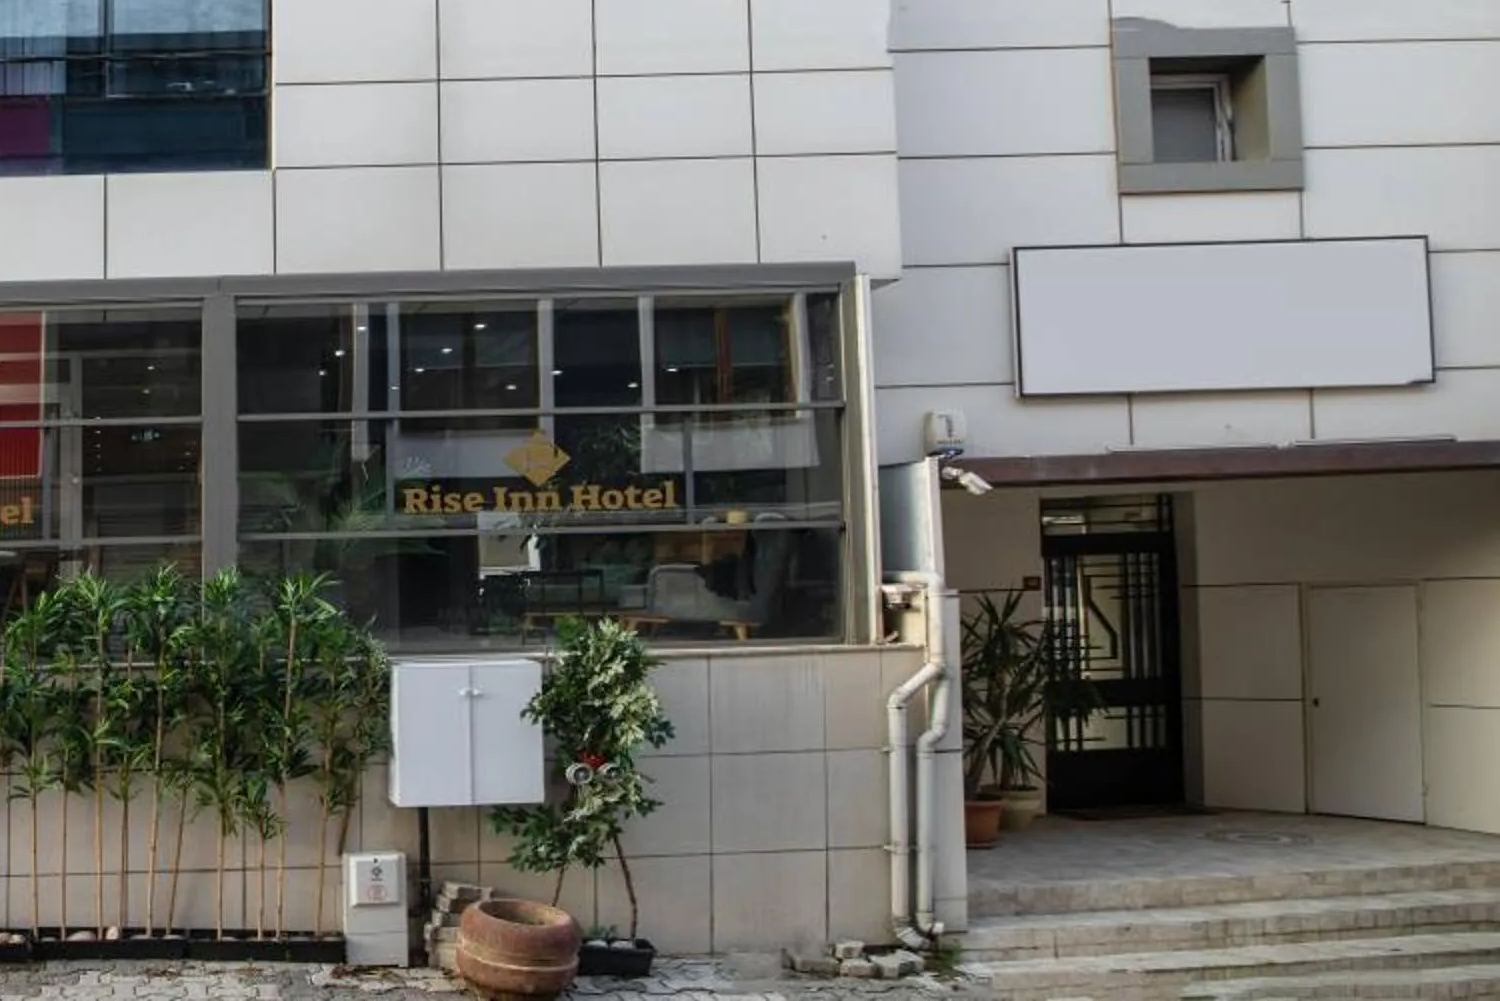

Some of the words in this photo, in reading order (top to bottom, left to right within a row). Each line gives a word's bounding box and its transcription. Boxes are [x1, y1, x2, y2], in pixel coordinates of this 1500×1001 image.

[402, 485, 485, 514] Rise
[493, 486, 561, 512] Inn
[570, 480, 681, 510] Hotel
